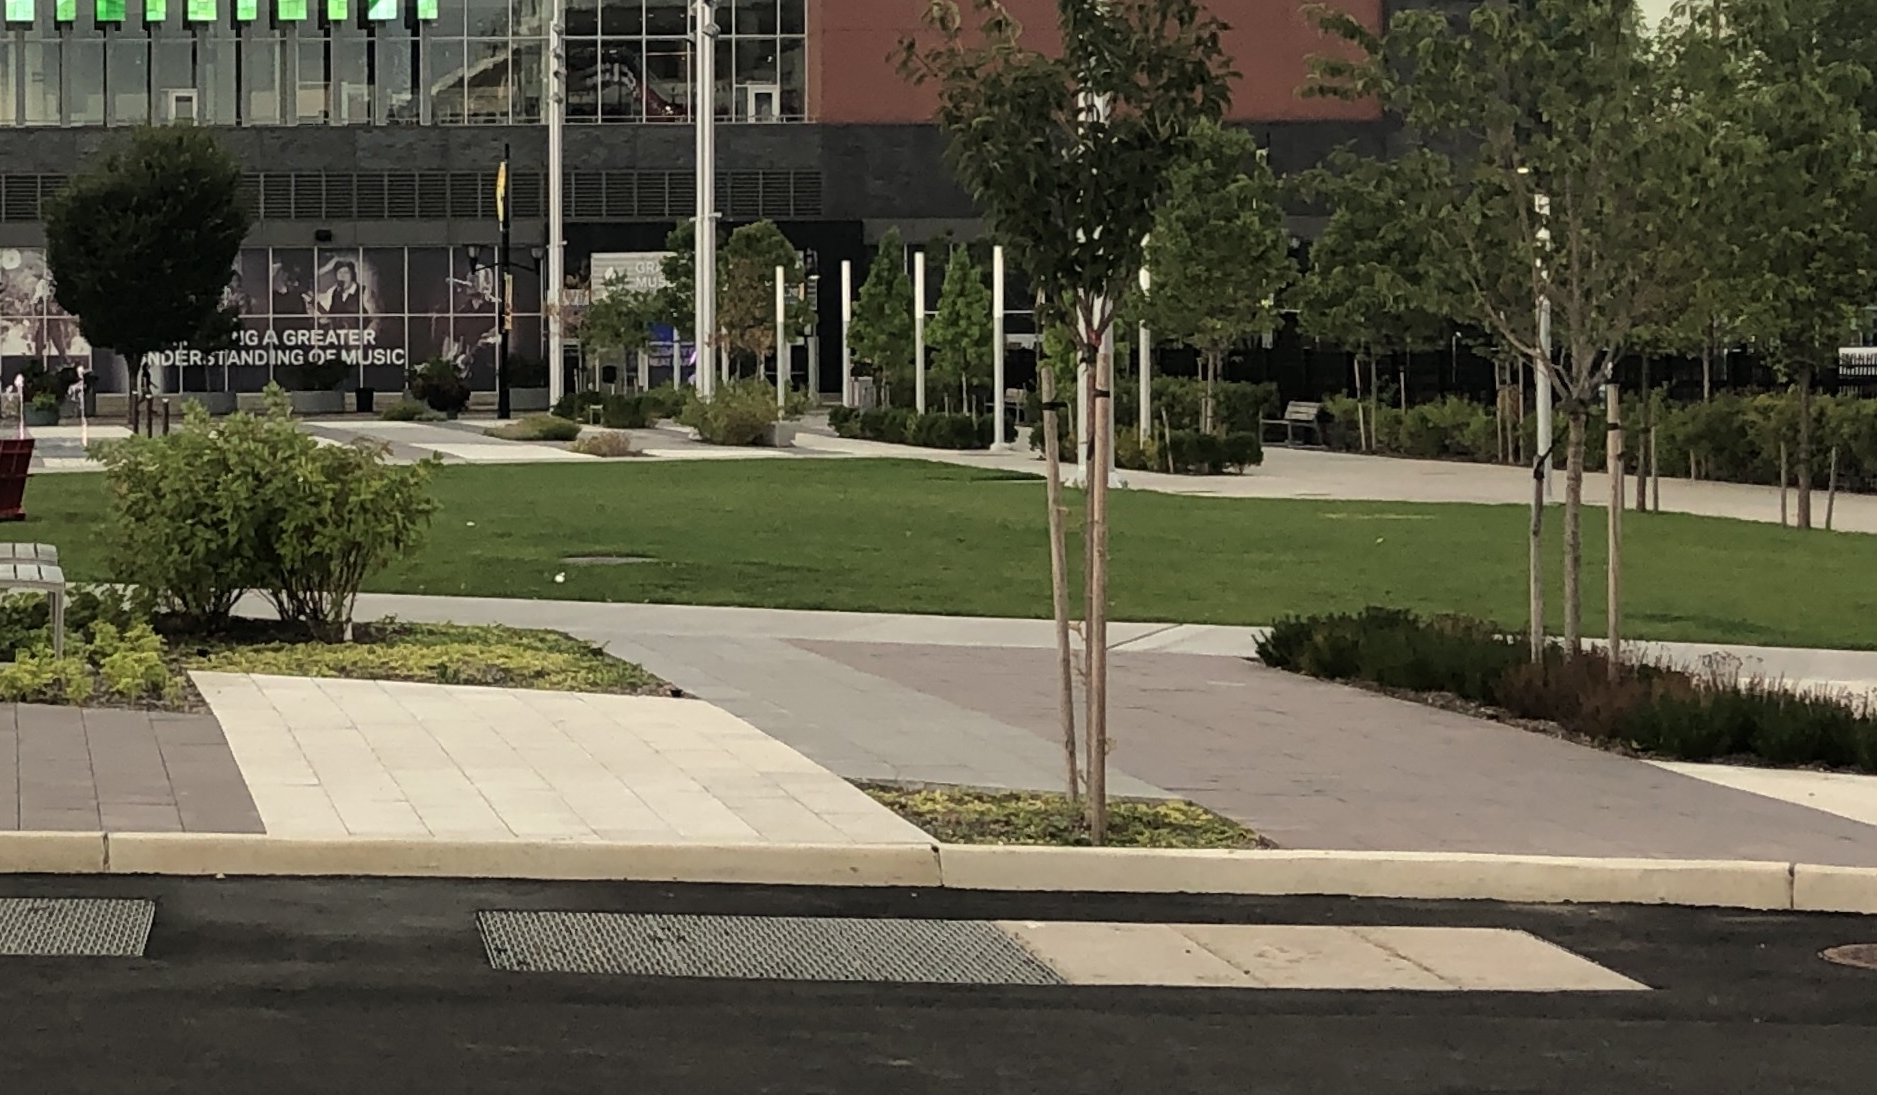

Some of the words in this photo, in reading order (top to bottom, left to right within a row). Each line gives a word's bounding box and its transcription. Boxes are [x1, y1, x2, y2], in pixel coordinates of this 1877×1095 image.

[262, 329, 279, 346] A
[283, 329, 376, 346] GREATER
[147, 349, 304, 366] NDERSTANDING
